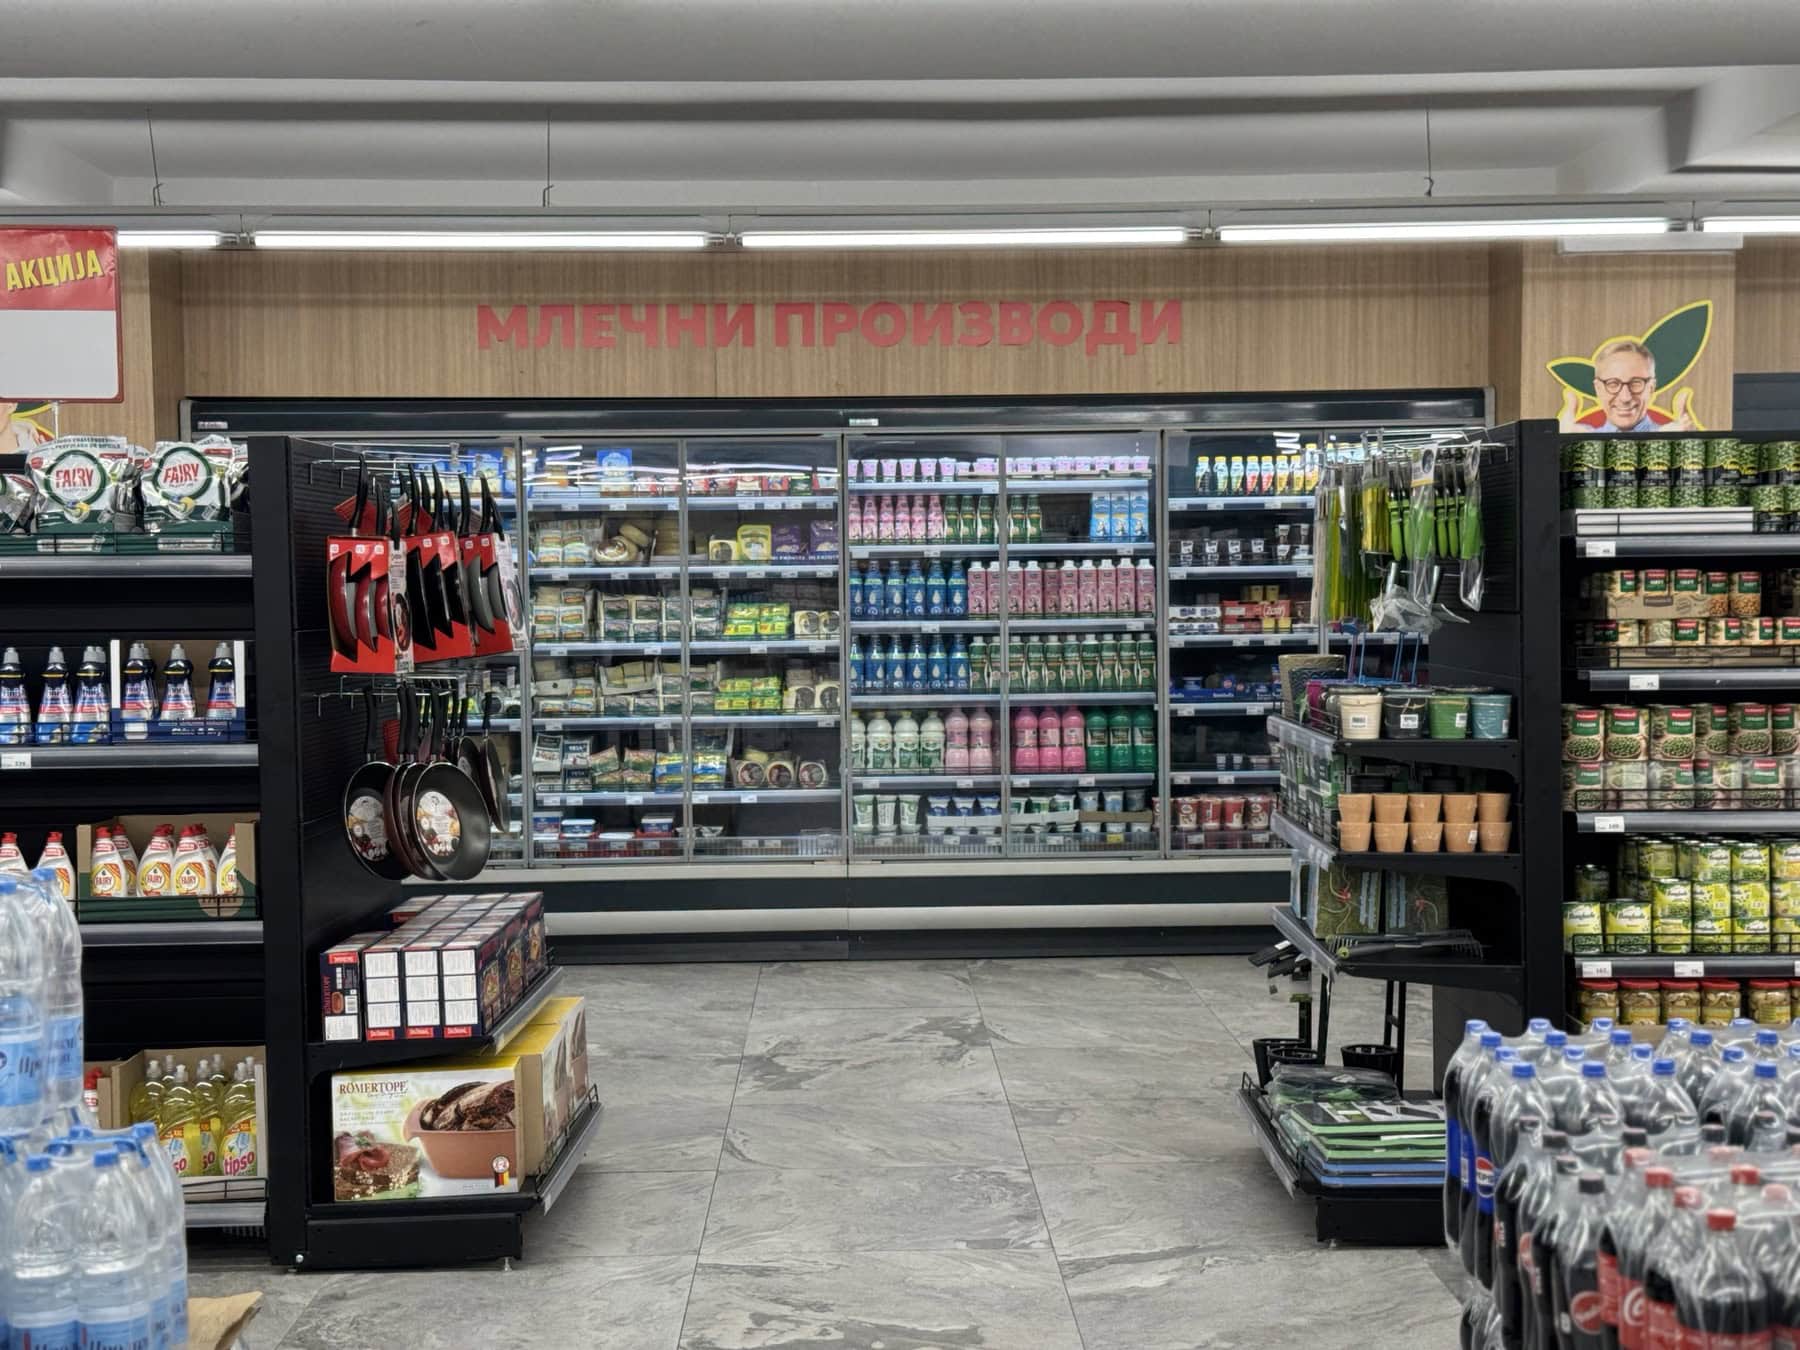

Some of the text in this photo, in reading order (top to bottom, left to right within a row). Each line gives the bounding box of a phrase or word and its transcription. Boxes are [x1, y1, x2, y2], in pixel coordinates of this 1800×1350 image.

[6, 249, 105, 292] АКЦИЈА
[476, 299, 1183, 357] МЛЕЧНИ ПРОИЗВОДИ
[55, 467, 95, 489] FAIRY
[163, 463, 201, 485] FAIRY
[224, 1151, 255, 1177] tipso
